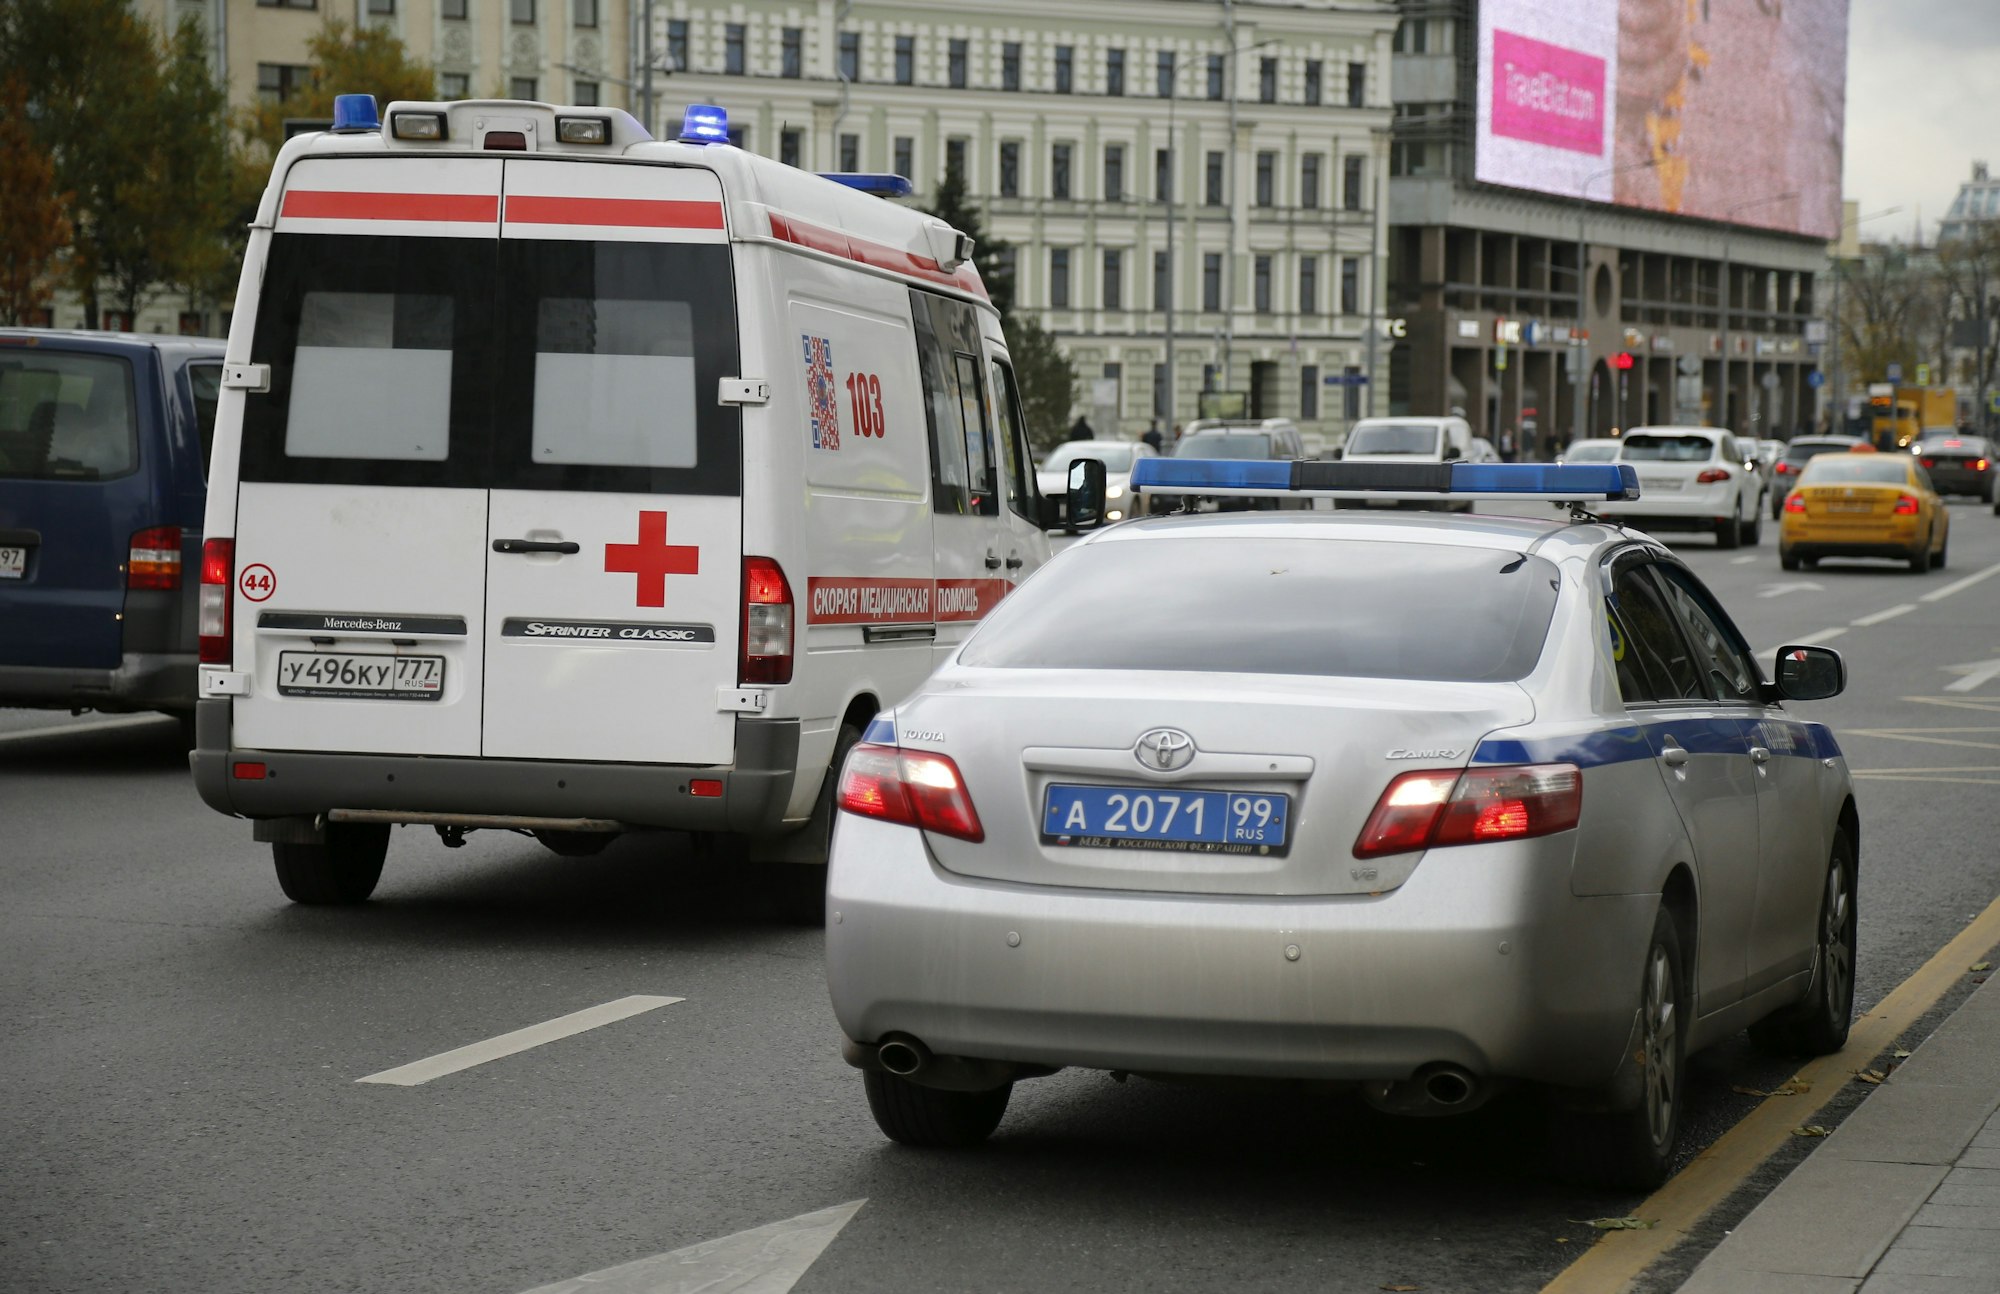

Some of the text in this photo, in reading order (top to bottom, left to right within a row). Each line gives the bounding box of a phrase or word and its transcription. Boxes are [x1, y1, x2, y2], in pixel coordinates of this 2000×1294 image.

[846, 372, 885, 438] 103
[245, 574, 270, 591] 44
[813, 587, 978, 618] СКОРАЯ МЕДИЦИНСКАЯ ПОМОЩЬ
[323, 617, 401, 631] Mercedes-Benz
[524, 622, 695, 641] SPRINTER CLASSIC
[397, 659, 435, 680] 777
[404, 680, 424, 688] RUS
[903, 729, 945, 742] TOYOTA
[1385, 748, 1465, 760] CAMRY
[1104, 794, 1205, 835] 2071
[1233, 797, 1272, 828] 99
[1236, 828, 1265, 841] RUS
